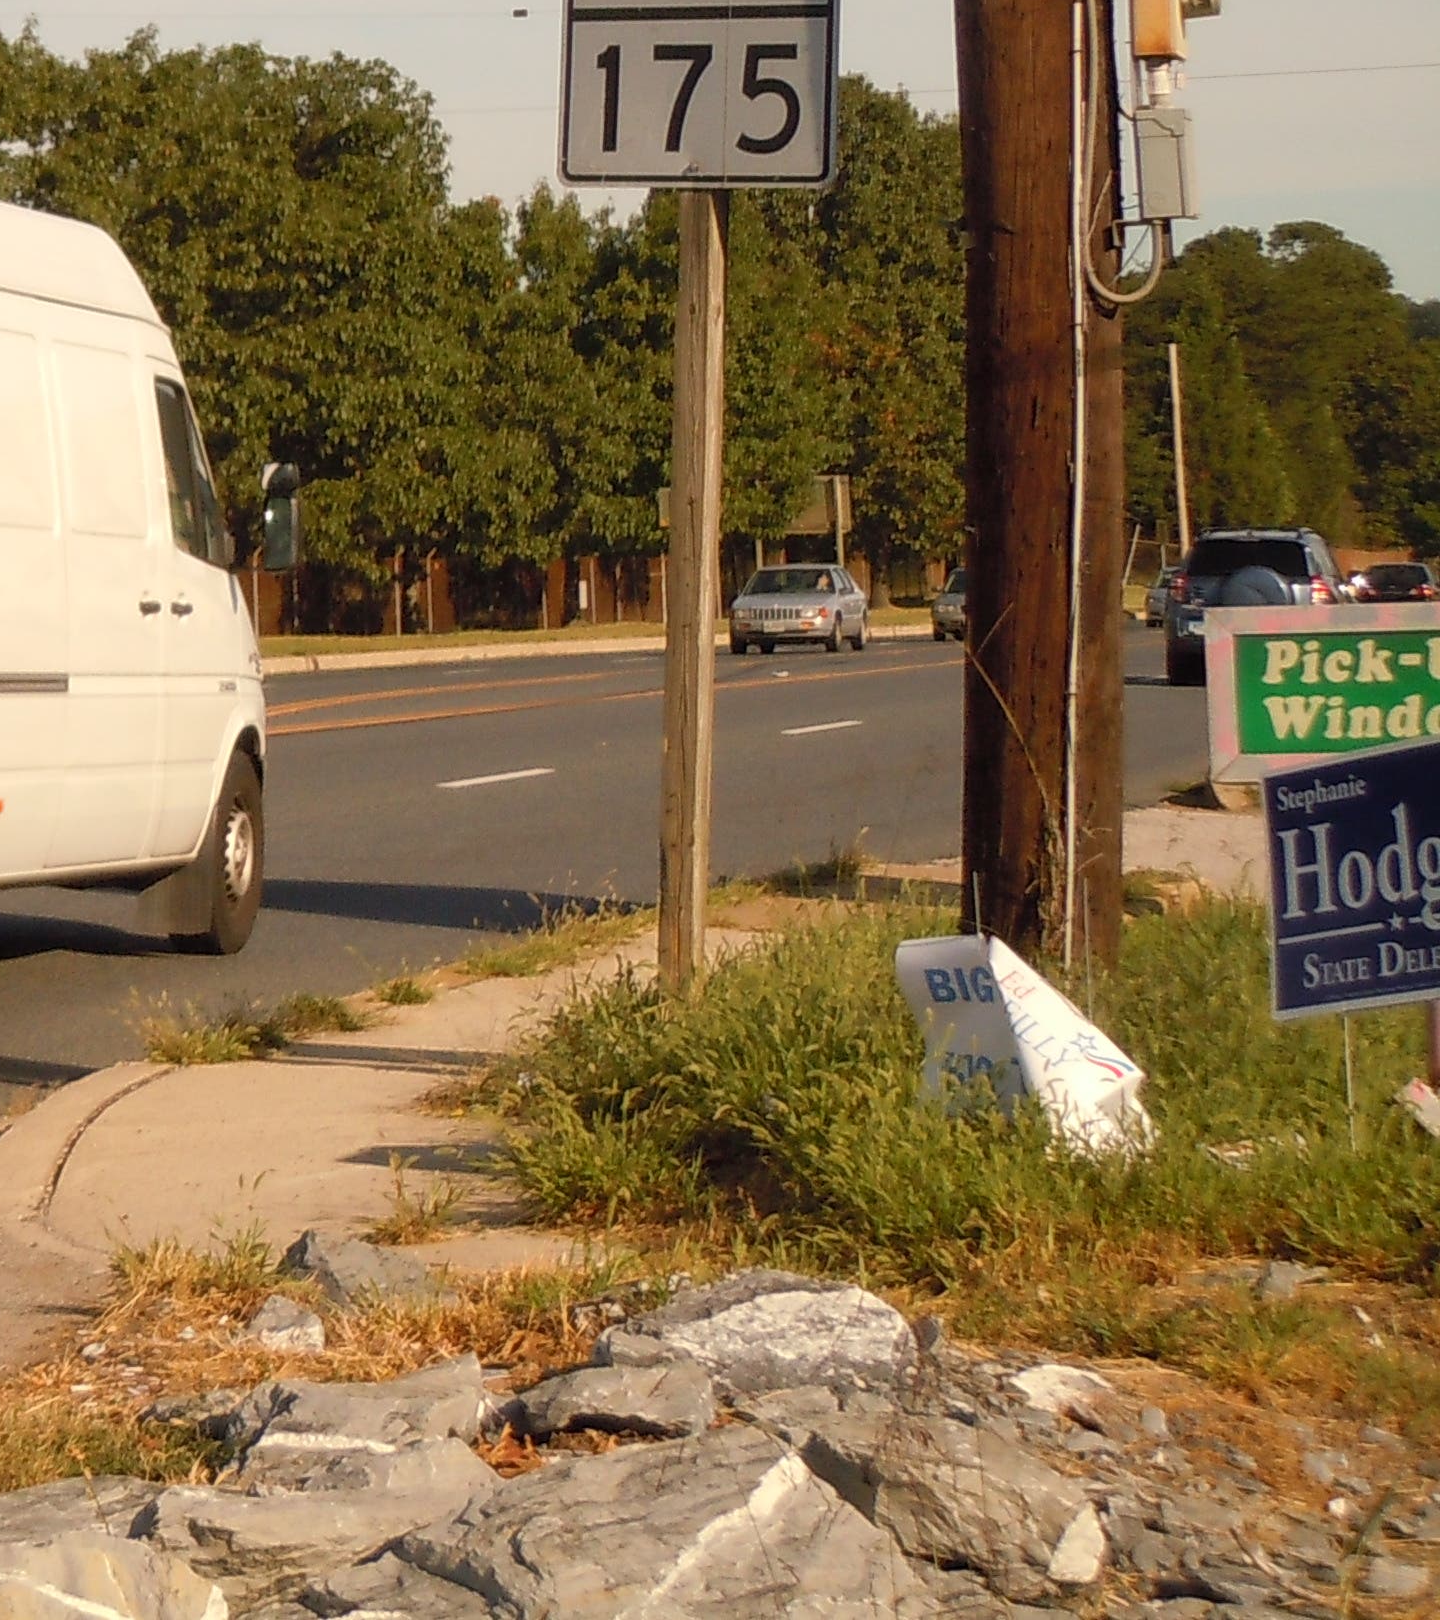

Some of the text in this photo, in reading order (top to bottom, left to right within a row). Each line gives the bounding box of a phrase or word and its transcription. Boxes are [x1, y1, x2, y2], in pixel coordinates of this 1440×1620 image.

[596, 42, 801, 155] 175
[1276, 775, 1368, 815] Stephanie
[924, 965, 995, 1004] BIG
[1302, 952, 1371, 989] STATE
